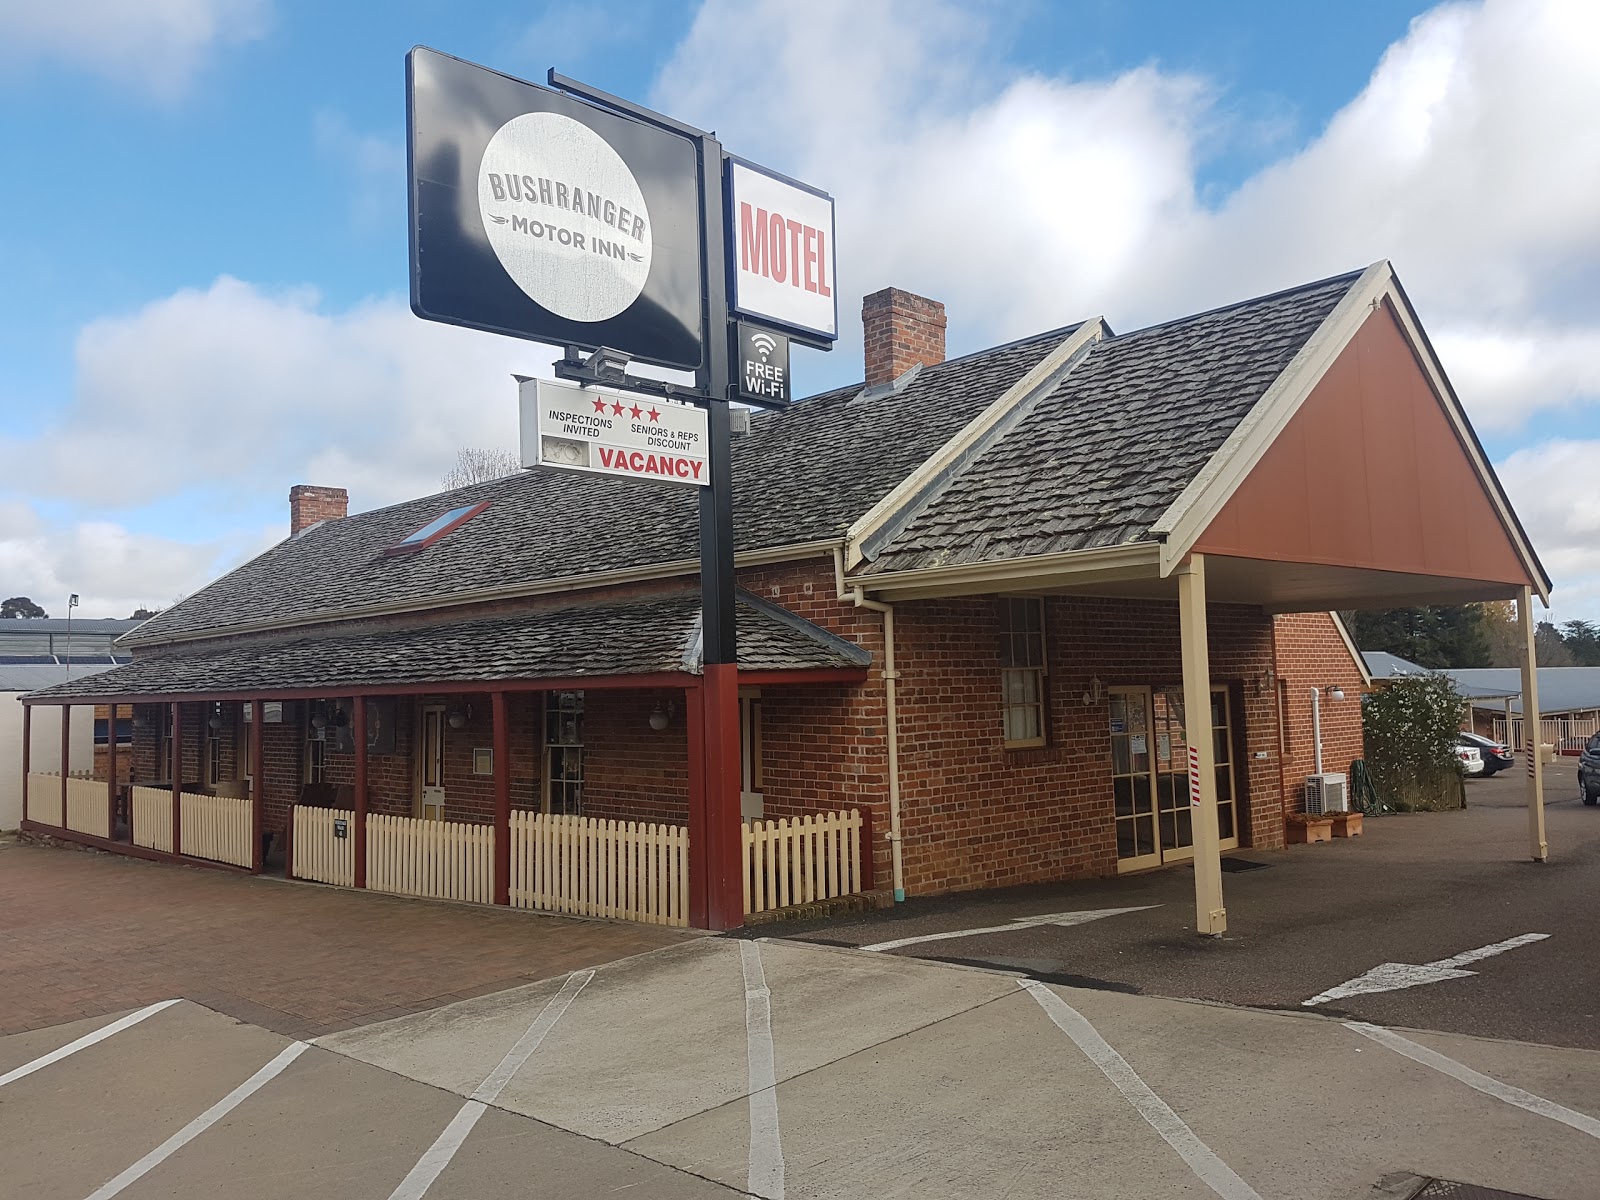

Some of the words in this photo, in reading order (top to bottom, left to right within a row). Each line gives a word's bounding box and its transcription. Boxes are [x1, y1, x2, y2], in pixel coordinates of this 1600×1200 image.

[488, 173, 646, 243] BUSHRANGER
[512, 214, 586, 250] MOTOR
[592, 236, 626, 261] INN
[740, 201, 831, 298] MOTEL
[746, 360, 783, 383] FREE
[745, 376, 784, 399] Wi-Fi
[549, 410, 613, 429] INSPECTIONS
[563, 424, 600, 438] INVITED
[630, 423, 668, 438] SENIORS
[670, 431, 675, 439] &
[677, 432, 699, 442] REPS
[647, 437, 692, 451] DISCOUNT
[599, 447, 703, 479] VACANCY
